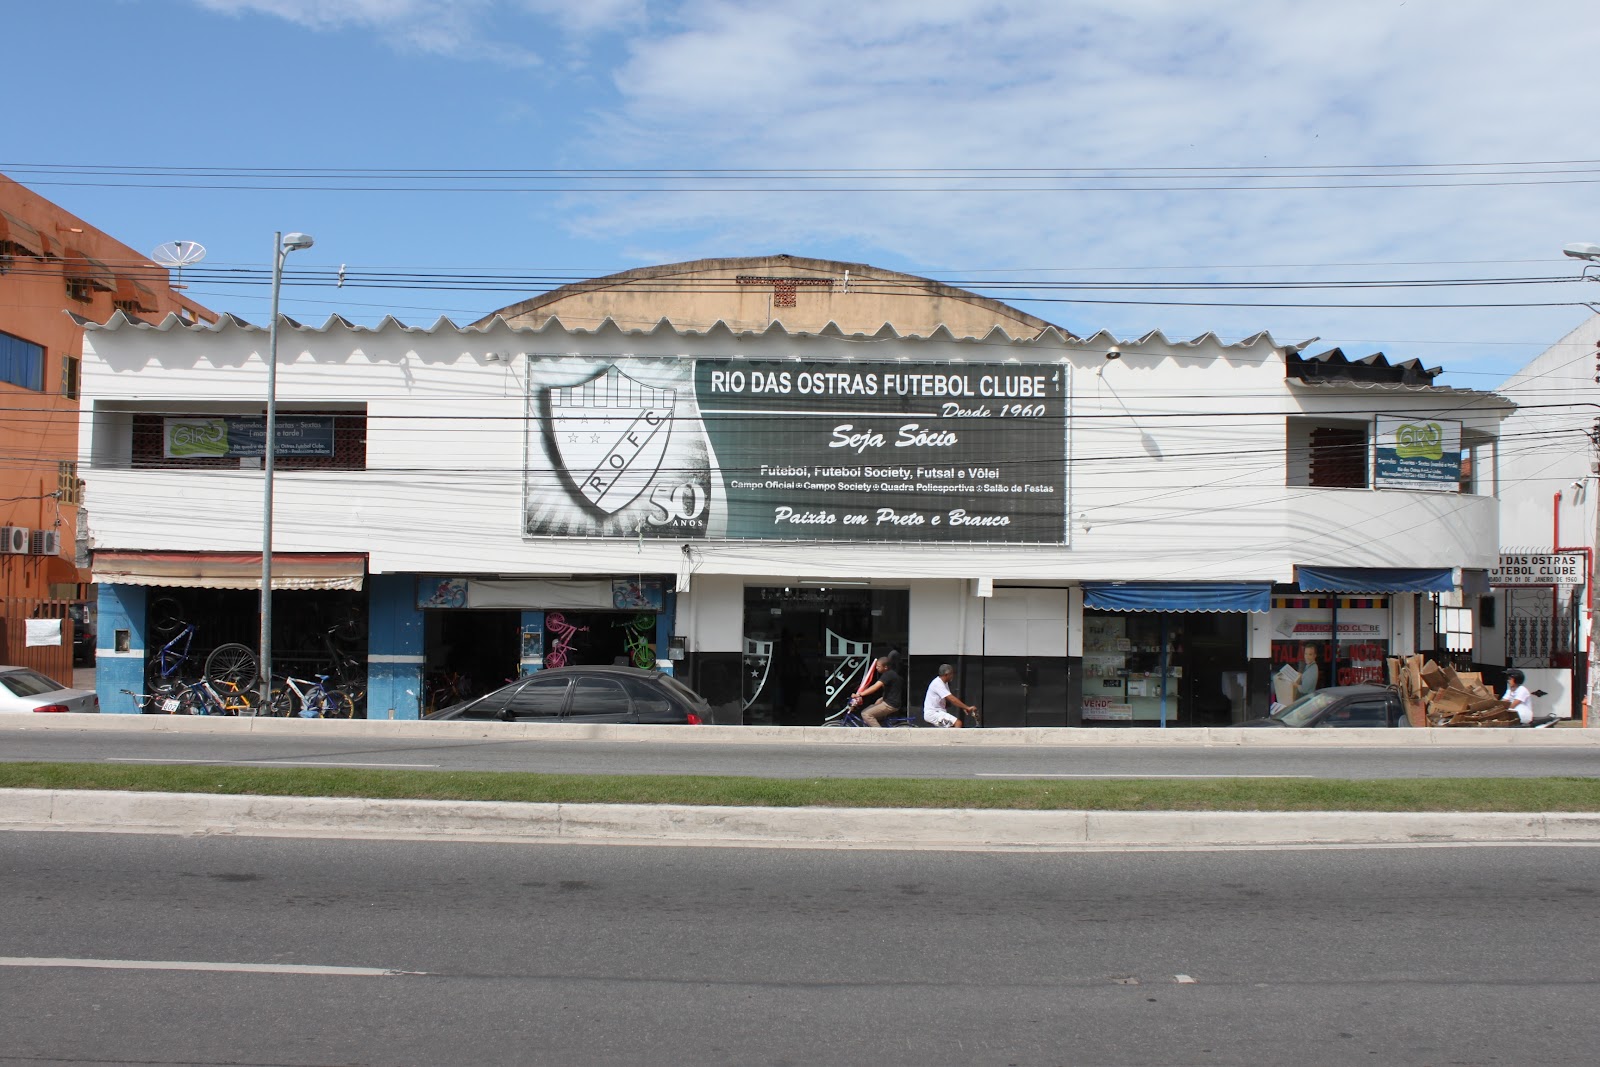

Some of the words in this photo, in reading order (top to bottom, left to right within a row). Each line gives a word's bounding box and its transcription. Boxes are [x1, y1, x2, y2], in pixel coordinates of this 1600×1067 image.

[711, 371, 746, 393] RIO
[750, 371, 792, 394] DAS
[797, 372, 878, 395] OSTRAS
[883, 373, 975, 396] FUTEBOL
[979, 375, 1046, 397] CLUBE
[941, 402, 992, 418] Desde
[999, 403, 1046, 419] 1960
[300, 421, 322, 429] Sextas
[828, 424, 887, 454] Seja
[894, 423, 959, 447] Sócio
[760, 464, 811, 478] Futebol,
[814, 466, 861, 478] Futebol
[864, 467, 914, 480] Society,
[916, 467, 955, 479] Futsal
[957, 470, 965, 479] e
[968, 467, 1000, 479] Vôlei
[730, 480, 764, 491] Campo
[765, 481, 795, 490] Oficial
[803, 481, 836, 491] Campo
[837, 482, 872, 493] Society
[880, 483, 914, 492] Quadra
[916, 483, 975, 494] Poliesportiva
[984, 484, 1009, 493] Salão
[1010, 484, 1023, 493] de
[1024, 484, 1054, 494] Festas
[645, 482, 709, 526] 50
[672, 519, 703, 527] ANOS
[774, 505, 838, 525] Paixão
[842, 513, 869, 525] em
[876, 507, 926, 526] Preto
[931, 514, 941, 526] e
[948, 508, 1011, 527] Branco
[1505, 556, 1528, 565] DAS
[1531, 556, 1576, 565] OSTRAS
[1491, 566, 1535, 575] UTEBOL
[1539, 566, 1577, 575] CLUBE
[256, 578, 282, 588] TL:
[1272, 639, 1306, 663] TALÃ
[1349, 643, 1384, 661] NOTA
